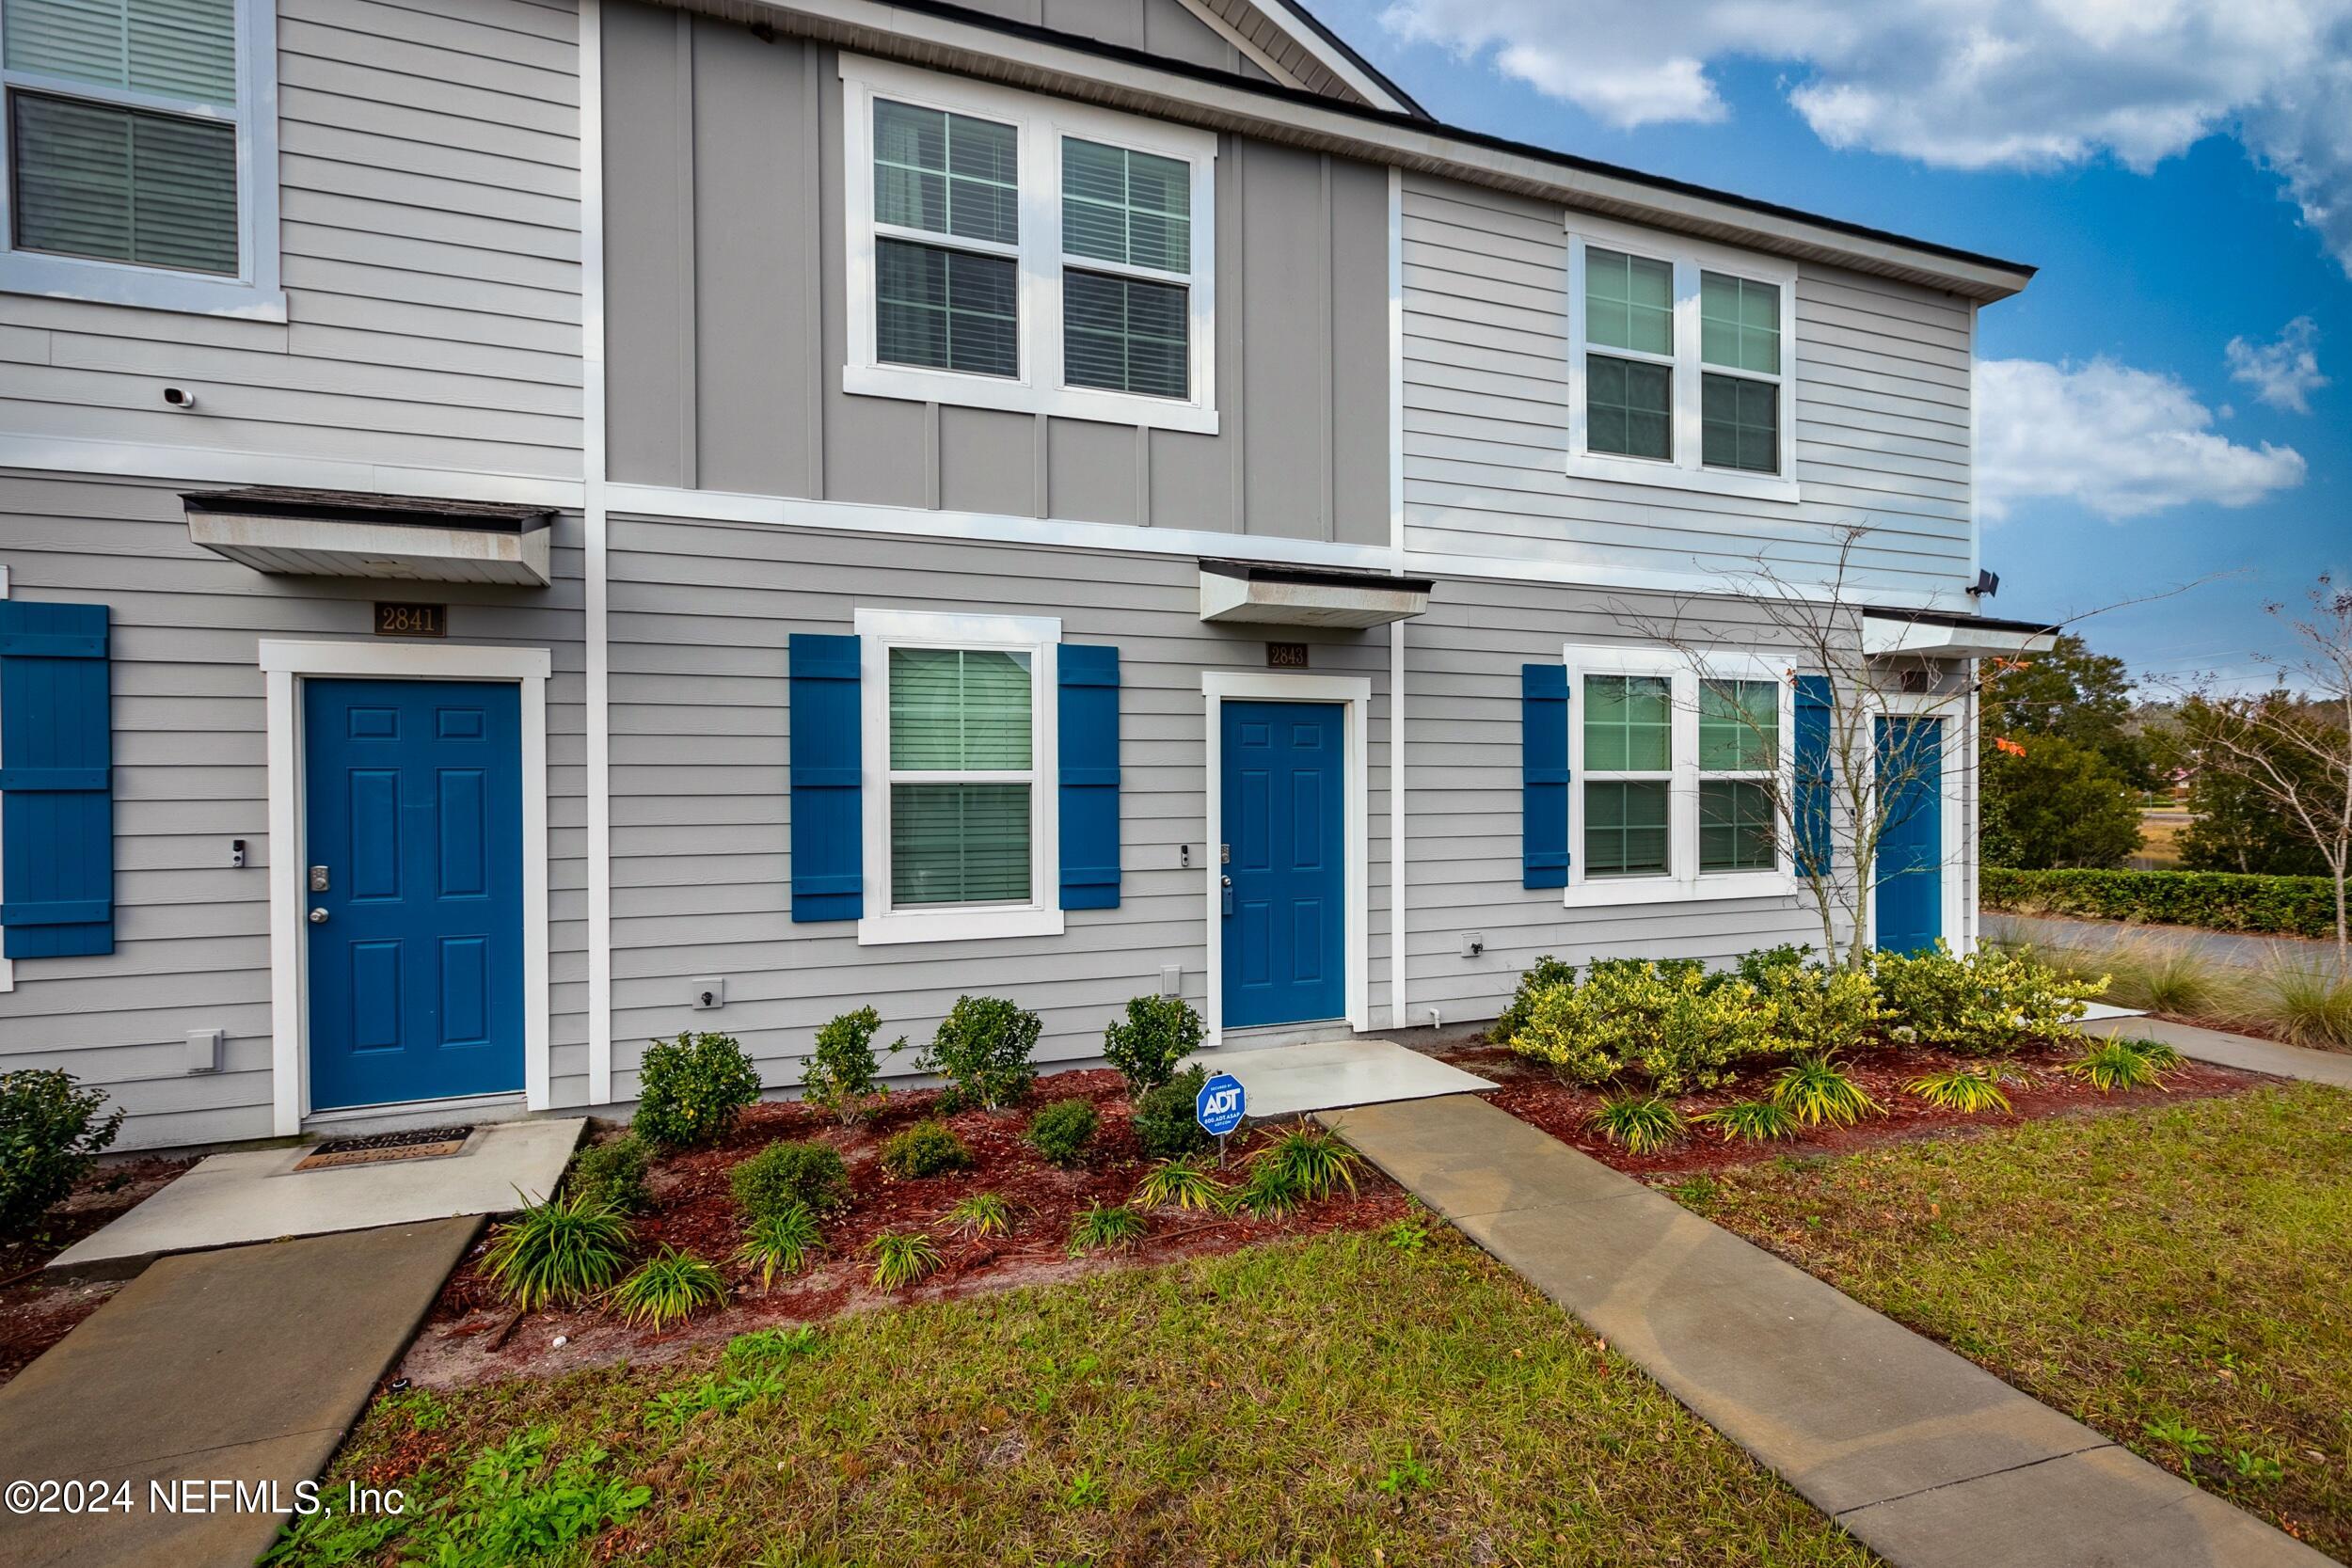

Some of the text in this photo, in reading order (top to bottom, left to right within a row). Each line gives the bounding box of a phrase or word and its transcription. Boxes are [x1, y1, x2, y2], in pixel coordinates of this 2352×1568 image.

[382, 607, 435, 631] 2841
[1272, 646, 1304, 664] 2843
[1203, 1087, 1241, 1117] ADT
[332, 1139, 421, 1152] COMING
